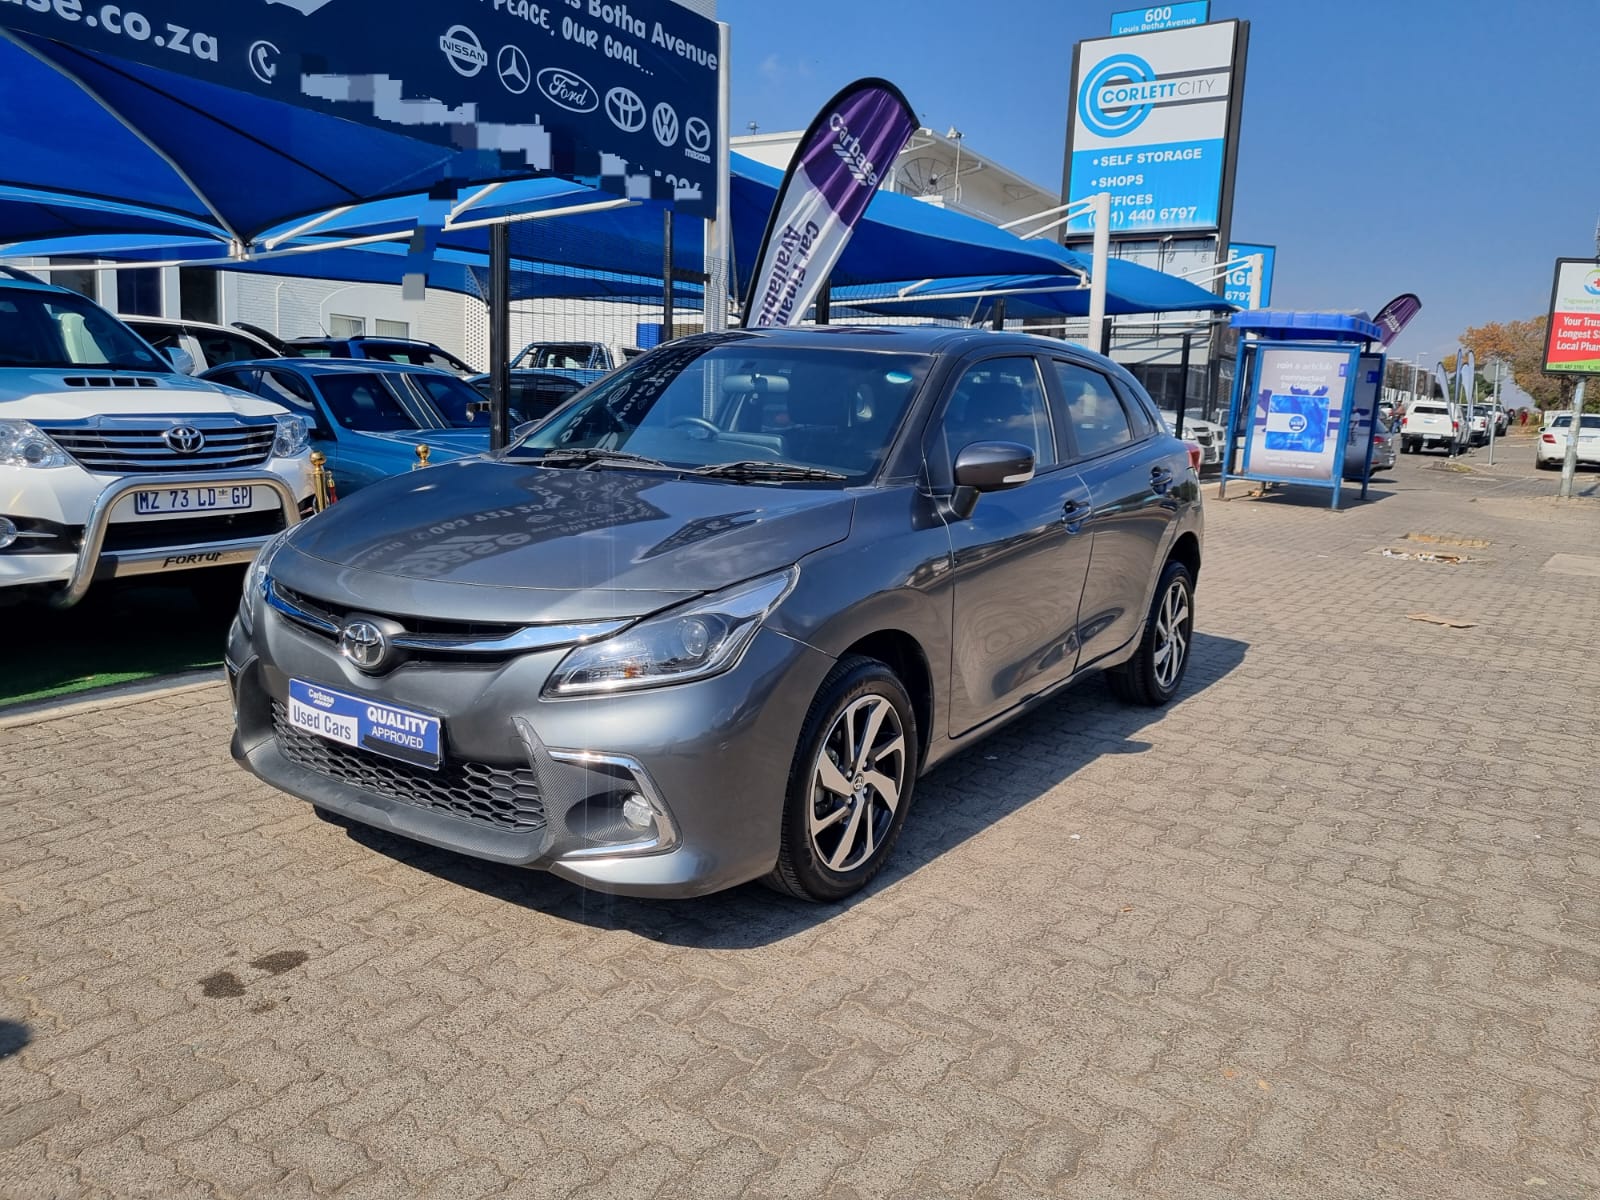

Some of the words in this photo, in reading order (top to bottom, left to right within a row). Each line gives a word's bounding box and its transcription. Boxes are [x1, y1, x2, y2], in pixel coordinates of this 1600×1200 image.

[1119, 25, 1140, 34] Louis
[1141, 21, 1165, 31] Botha
[1166, 17, 1198, 28] Avenue
[1144, 6, 1172, 23] 600
[562, 16, 600, 50] OUR
[588, 0, 646, 39] Botha
[651, 22, 718, 71] Avenue
[442, 39, 486, 63] NISSAN
[548, 73, 588, 106] Ford
[829, 113, 878, 186] Carbase
[1100, 153, 1134, 167] SELF
[1137, 148, 1203, 164] STORAGE
[1098, 174, 1144, 188] SHOPS
[1128, 208, 1156, 221] 440
[1160, 206, 1198, 220] 6797
[1563, 316, 1583, 327] Your
[1556, 340, 1580, 351] Local
[1557, 328, 1592, 341] Longest
[139, 492, 160, 510] MZ
[169, 489, 189, 508] 73
[231, 486, 249, 505] GP
[293, 704, 320, 730] Used
[324, 715, 352, 741] Cars
[367, 706, 429, 736] QUALITY
[371, 725, 424, 750] APPROVED
